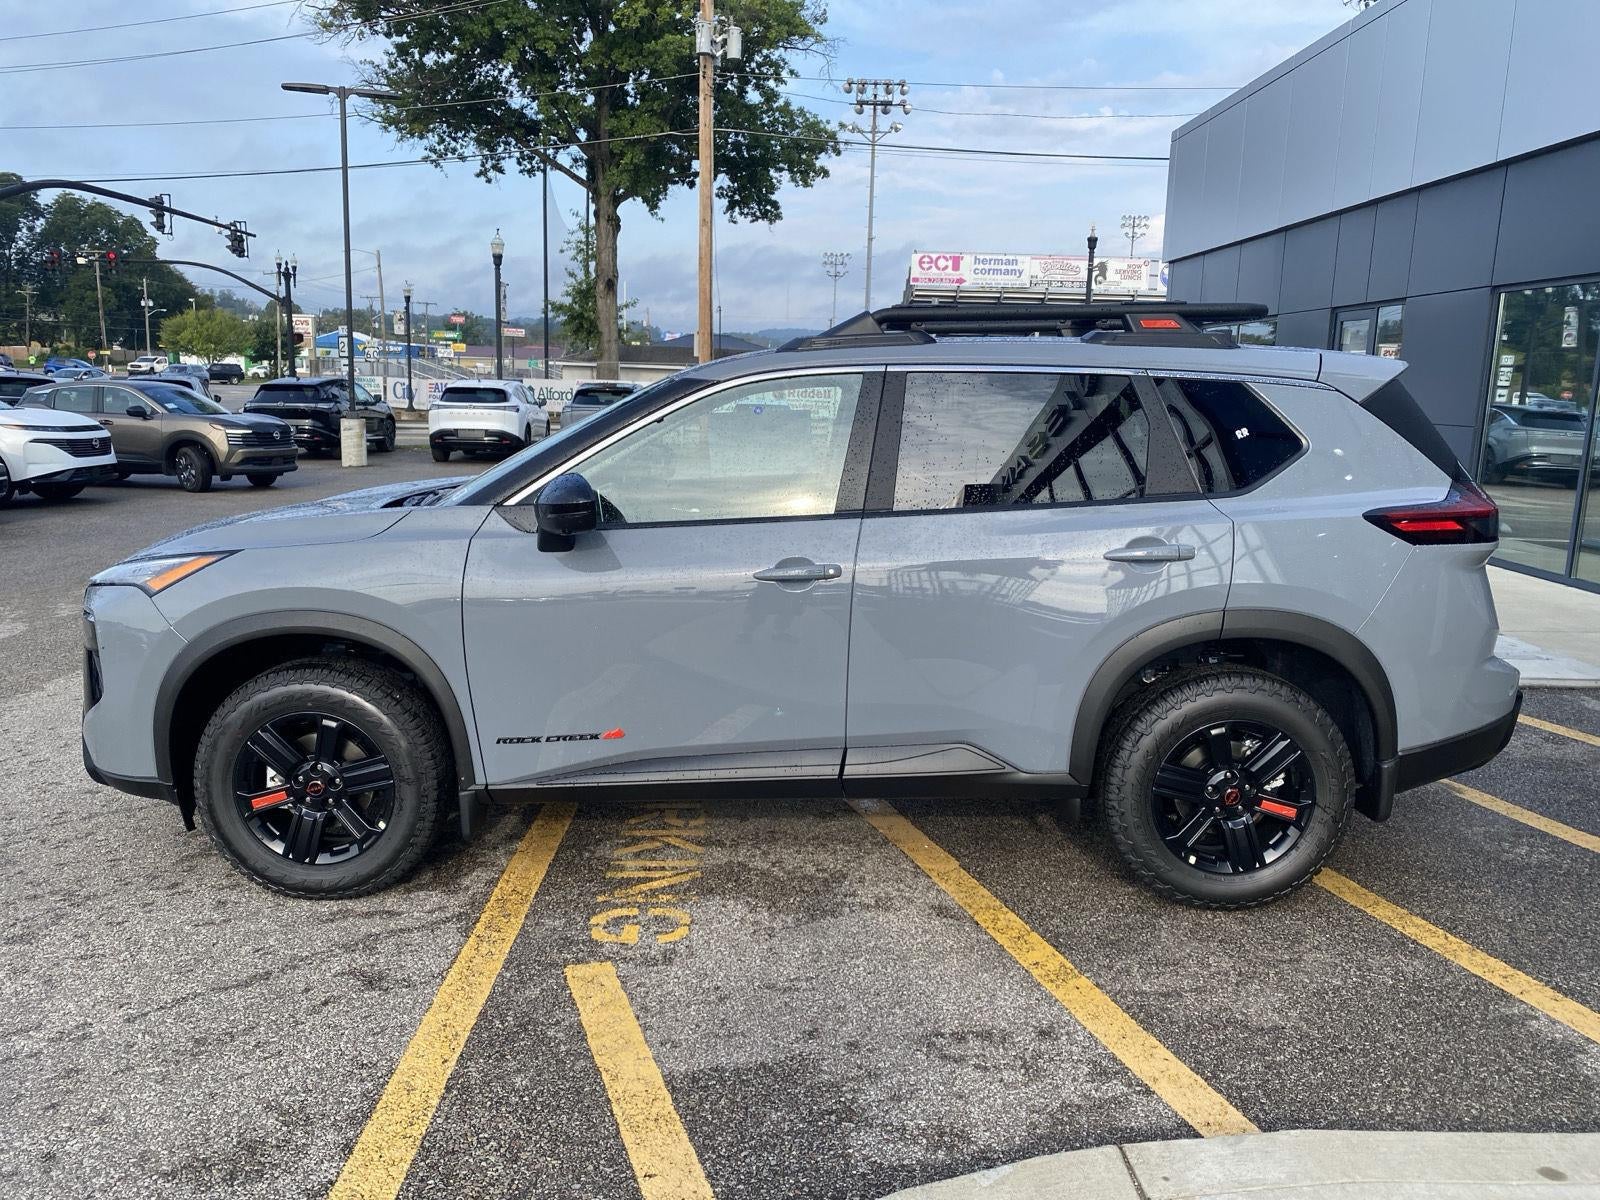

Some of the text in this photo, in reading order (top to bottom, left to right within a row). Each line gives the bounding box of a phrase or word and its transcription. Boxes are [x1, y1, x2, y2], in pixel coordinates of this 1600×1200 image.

[974, 256, 1018, 266] herman
[973, 267, 1024, 278] cormany
[366, 350, 379, 359] 60
[537, 386, 574, 401] Alford
[1235, 427, 1250, 440] RR
[496, 733, 601, 745] ROCK CREEK
[589, 802, 707, 945] RKING
